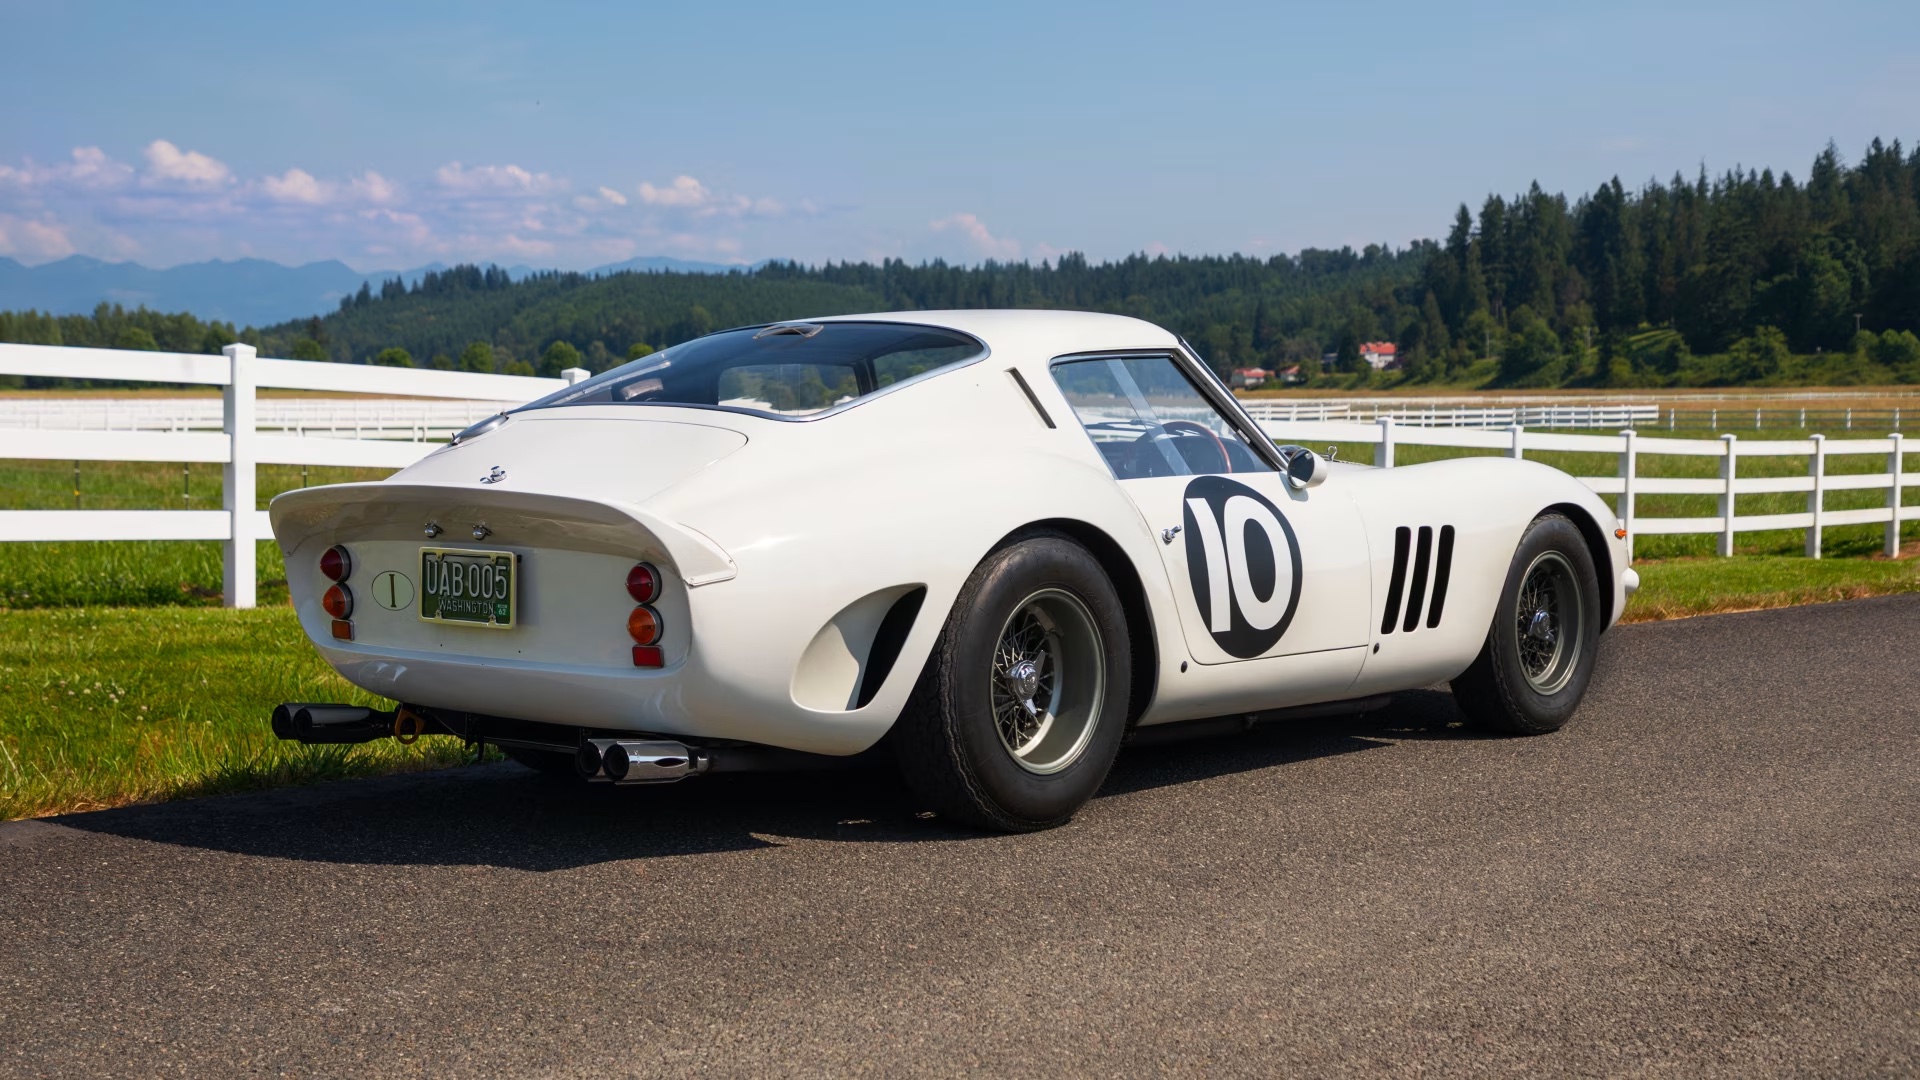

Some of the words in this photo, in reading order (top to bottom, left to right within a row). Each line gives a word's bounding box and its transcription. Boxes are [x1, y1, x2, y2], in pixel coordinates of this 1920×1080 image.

[427, 561, 463, 597] UAB
[468, 563, 507, 600] 005
[1185, 495, 1293, 633] 10
[438, 600, 495, 615] WASHINGTON
